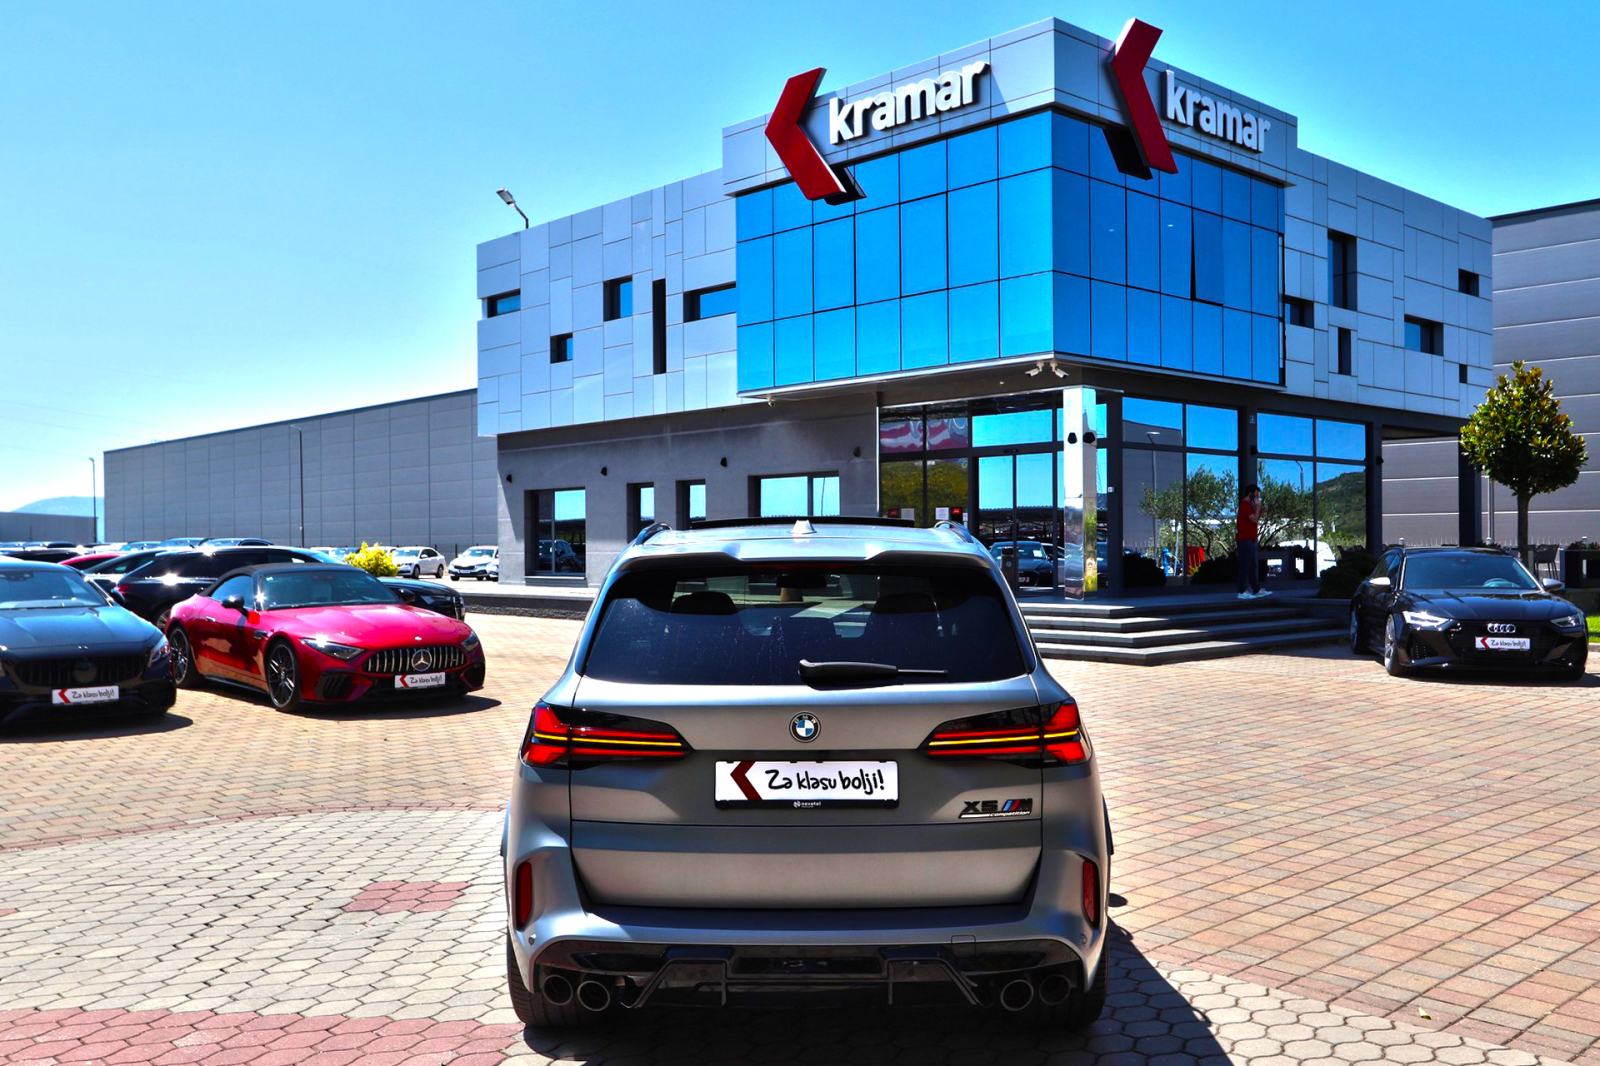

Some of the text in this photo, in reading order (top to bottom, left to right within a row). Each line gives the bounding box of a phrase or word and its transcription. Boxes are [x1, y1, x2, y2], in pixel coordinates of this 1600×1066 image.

[829, 60, 988, 145] kramar
[1165, 69, 1271, 154] kramar
[765, 768, 885, 796] Za klasu bolji!
[961, 799, 998, 813] X5
